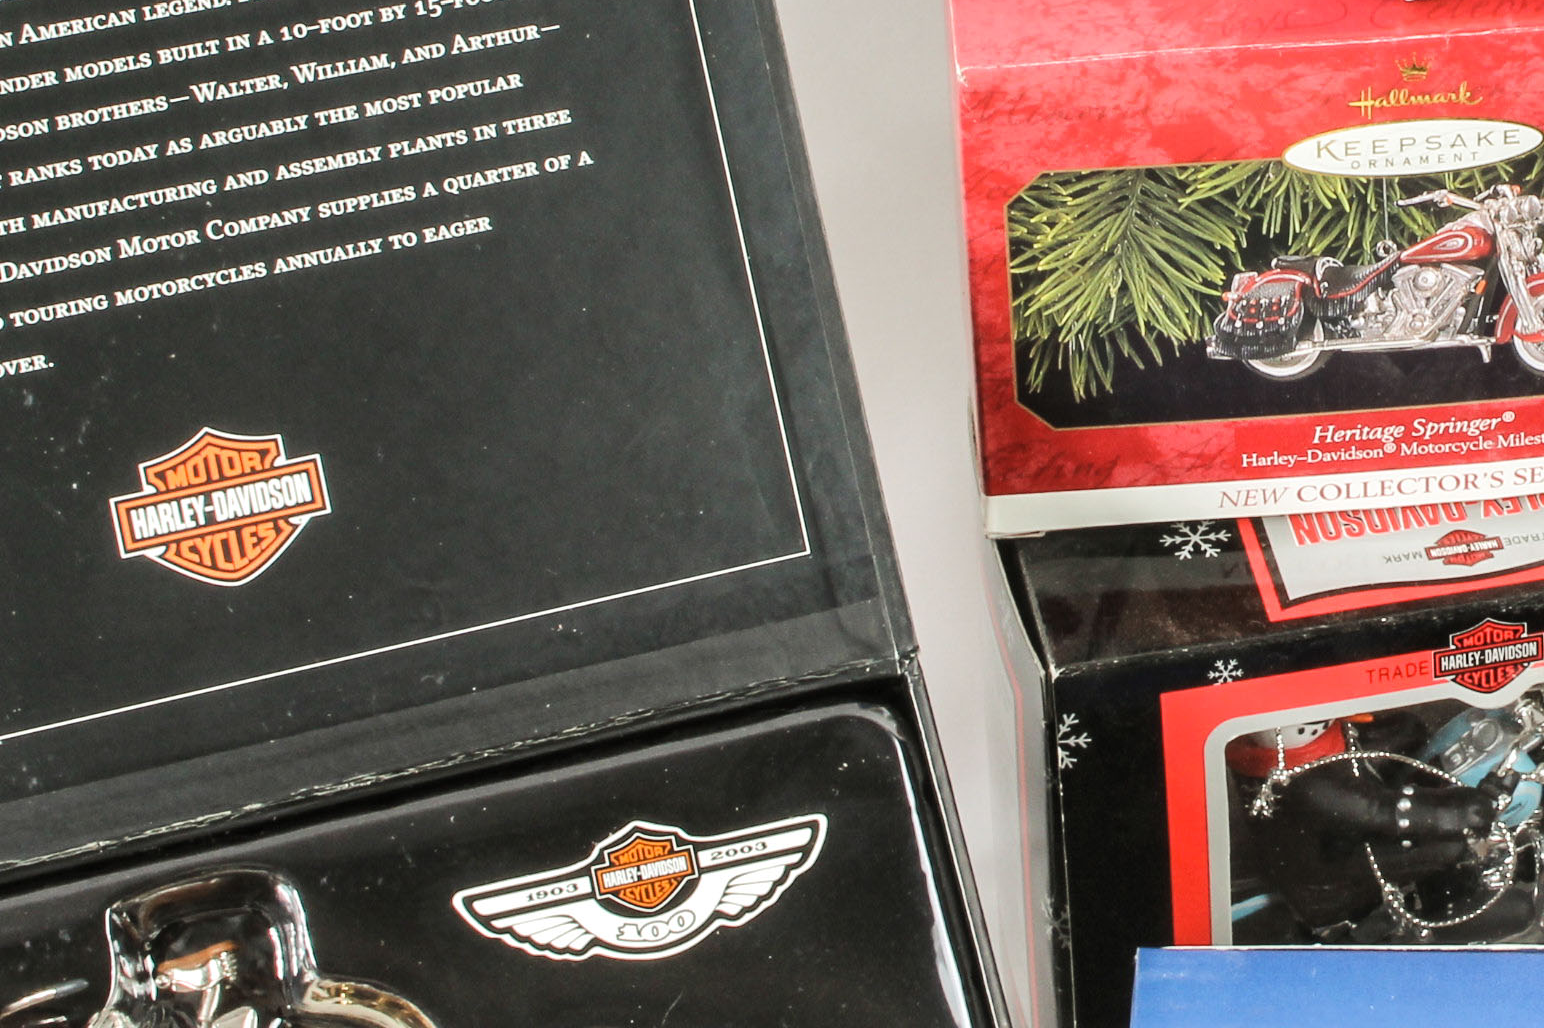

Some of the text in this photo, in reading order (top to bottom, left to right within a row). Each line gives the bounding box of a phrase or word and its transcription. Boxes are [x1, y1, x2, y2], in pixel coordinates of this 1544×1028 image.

[19, 8, 136, 45] AMERICAN
[65, 53, 152, 83] MODELS
[158, 40, 219, 64] BUILT
[226, 34, 250, 51] IN
[379, 3, 406, 22] BY
[291, 54, 395, 83] WILLIAM,
[402, 44, 445, 65] AND
[1349, 82, 1484, 119] Hallmark
[9, 73, 523, 187] RANKS TODAY AS ARGUABLY THE MOST POPULAR
[1316, 129, 1520, 162] KEEPSAKE
[32, 110, 571, 229] MANUFACTURING AND ASSEMBLY PLANTS IN THREE
[1350, 151, 1480, 170] ORNAMENT
[0, 159, 539, 283] DAVIDSON MOTOR COMPANY SUPPLIES QUARTER
[11, 217, 492, 327] TOURING MOTORCYCLES ANNUALLY TO EAGER
[1312, 423, 1405, 445] Heritage
[1400, 439, 1493, 458] Motorcycle
[166, 445, 262, 490] MOTOR
[130, 472, 312, 540] HARLEY-DAVIDSON
[1218, 486, 1288, 509] NEW
[1296, 470, 1505, 504] COLLECTOR'S
[179, 522, 277, 570] CYCLES
[1384, 552, 1423, 564] MARK
[1463, 627, 1514, 647] MOTOR
[1367, 661, 1430, 684] TRADE
[1441, 641, 1538, 672] HARLEY-DAVIDSON
[1464, 666, 1517, 688] CYCLES
[619, 845, 661, 864] MOTOR
[710, 840, 768, 862] 2003
[602, 856, 688, 889] HARLEY-DAVIDSON
[526, 883, 579, 902] 1903
[626, 880, 671, 902] CYCLES
[616, 909, 696, 942] 100
